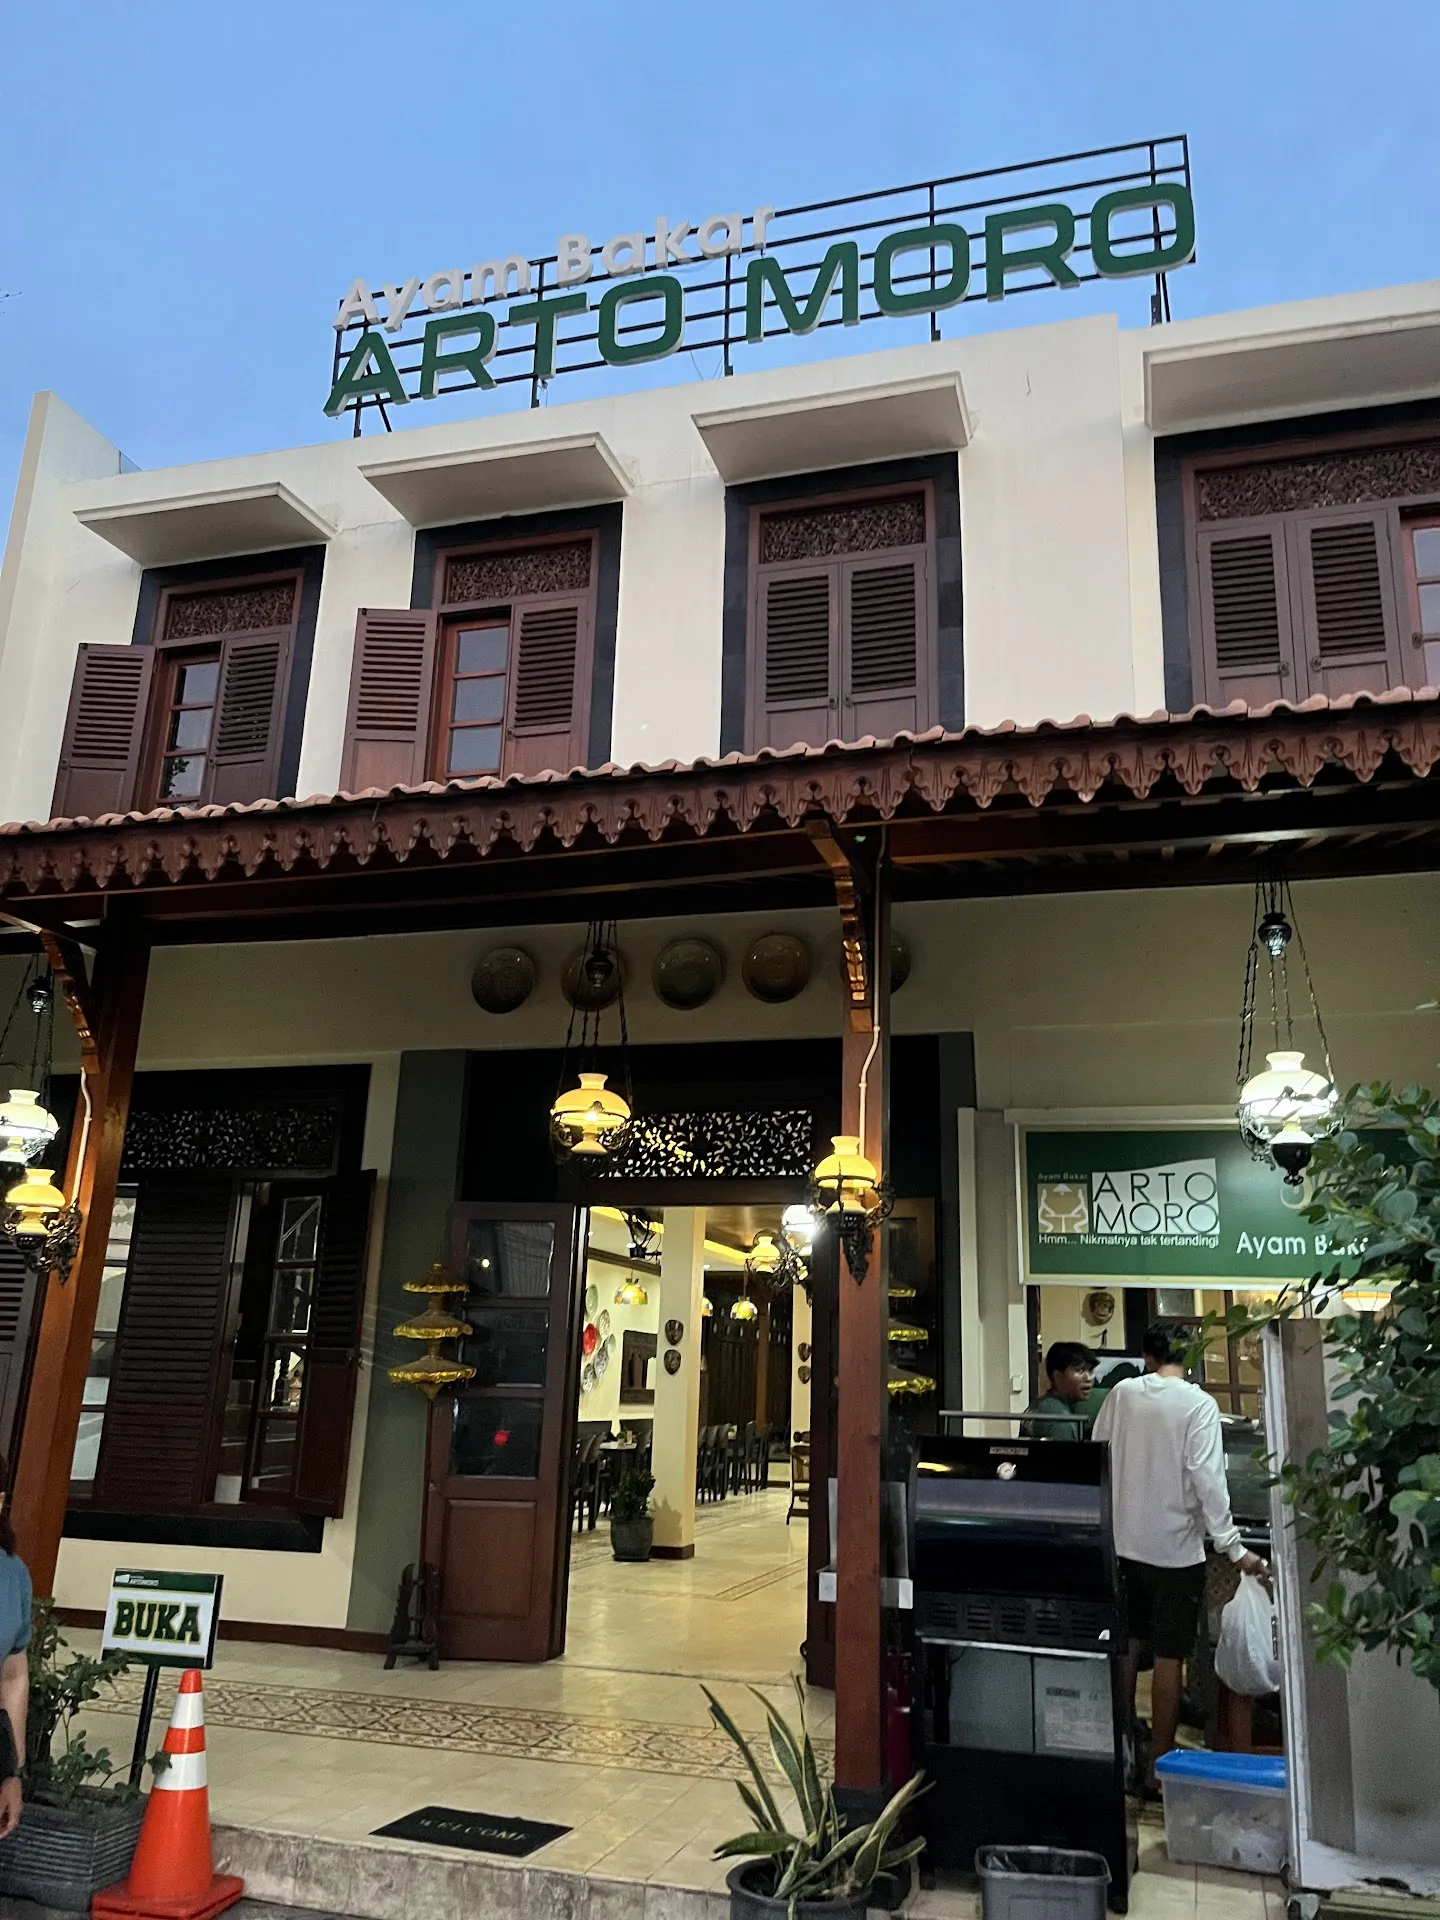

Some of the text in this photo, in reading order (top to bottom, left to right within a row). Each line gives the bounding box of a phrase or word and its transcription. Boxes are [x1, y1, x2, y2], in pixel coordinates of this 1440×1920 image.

[333, 205, 774, 333] Ayam Bakar
[323, 182, 1196, 417] ARTO MORO
[1093, 1172, 1217, 1202] ARTO
[1094, 1202, 1218, 1233] MORO
[1038, 1234, 1220, 1248] Hmm... Nikmatnya tak tertandingi
[1236, 1231, 1306, 1259] Ayam
[112, 1600, 200, 1644] BUKA
